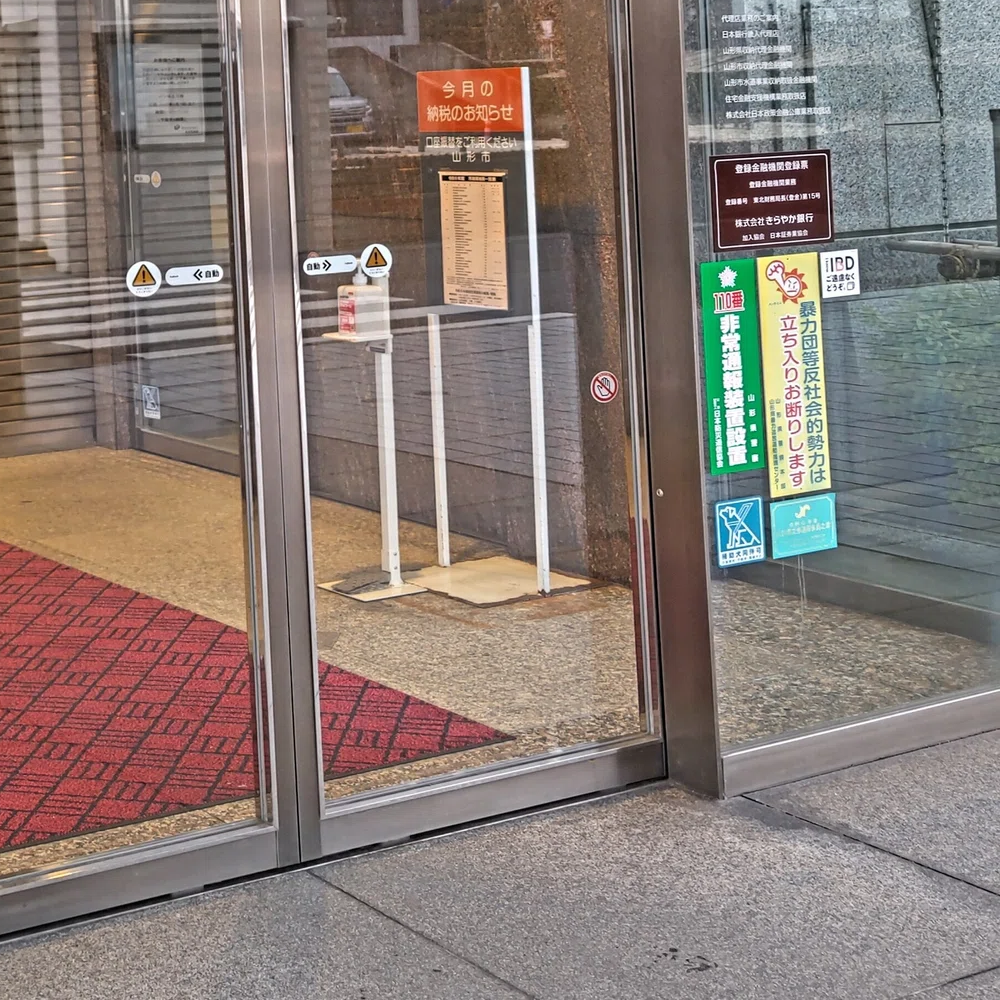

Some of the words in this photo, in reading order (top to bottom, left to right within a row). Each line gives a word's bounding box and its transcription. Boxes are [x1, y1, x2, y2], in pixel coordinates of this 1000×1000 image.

[442, 80, 493, 98] 今月の
[426, 104, 514, 122] 納税のお知らせ
[452, 151, 491, 163] 山形市
[735, 160, 809, 174] 登録金融機関登録票
[735, 213, 814, 228] 株式会社きらやか銀行
[713, 290, 744, 309] 110番
[720, 314, 747, 466] 非常通報装置設置
[799, 300, 827, 484] 暴力団等反社会的勢力は
[779, 315, 805, 487] 立ち入りお断りします
